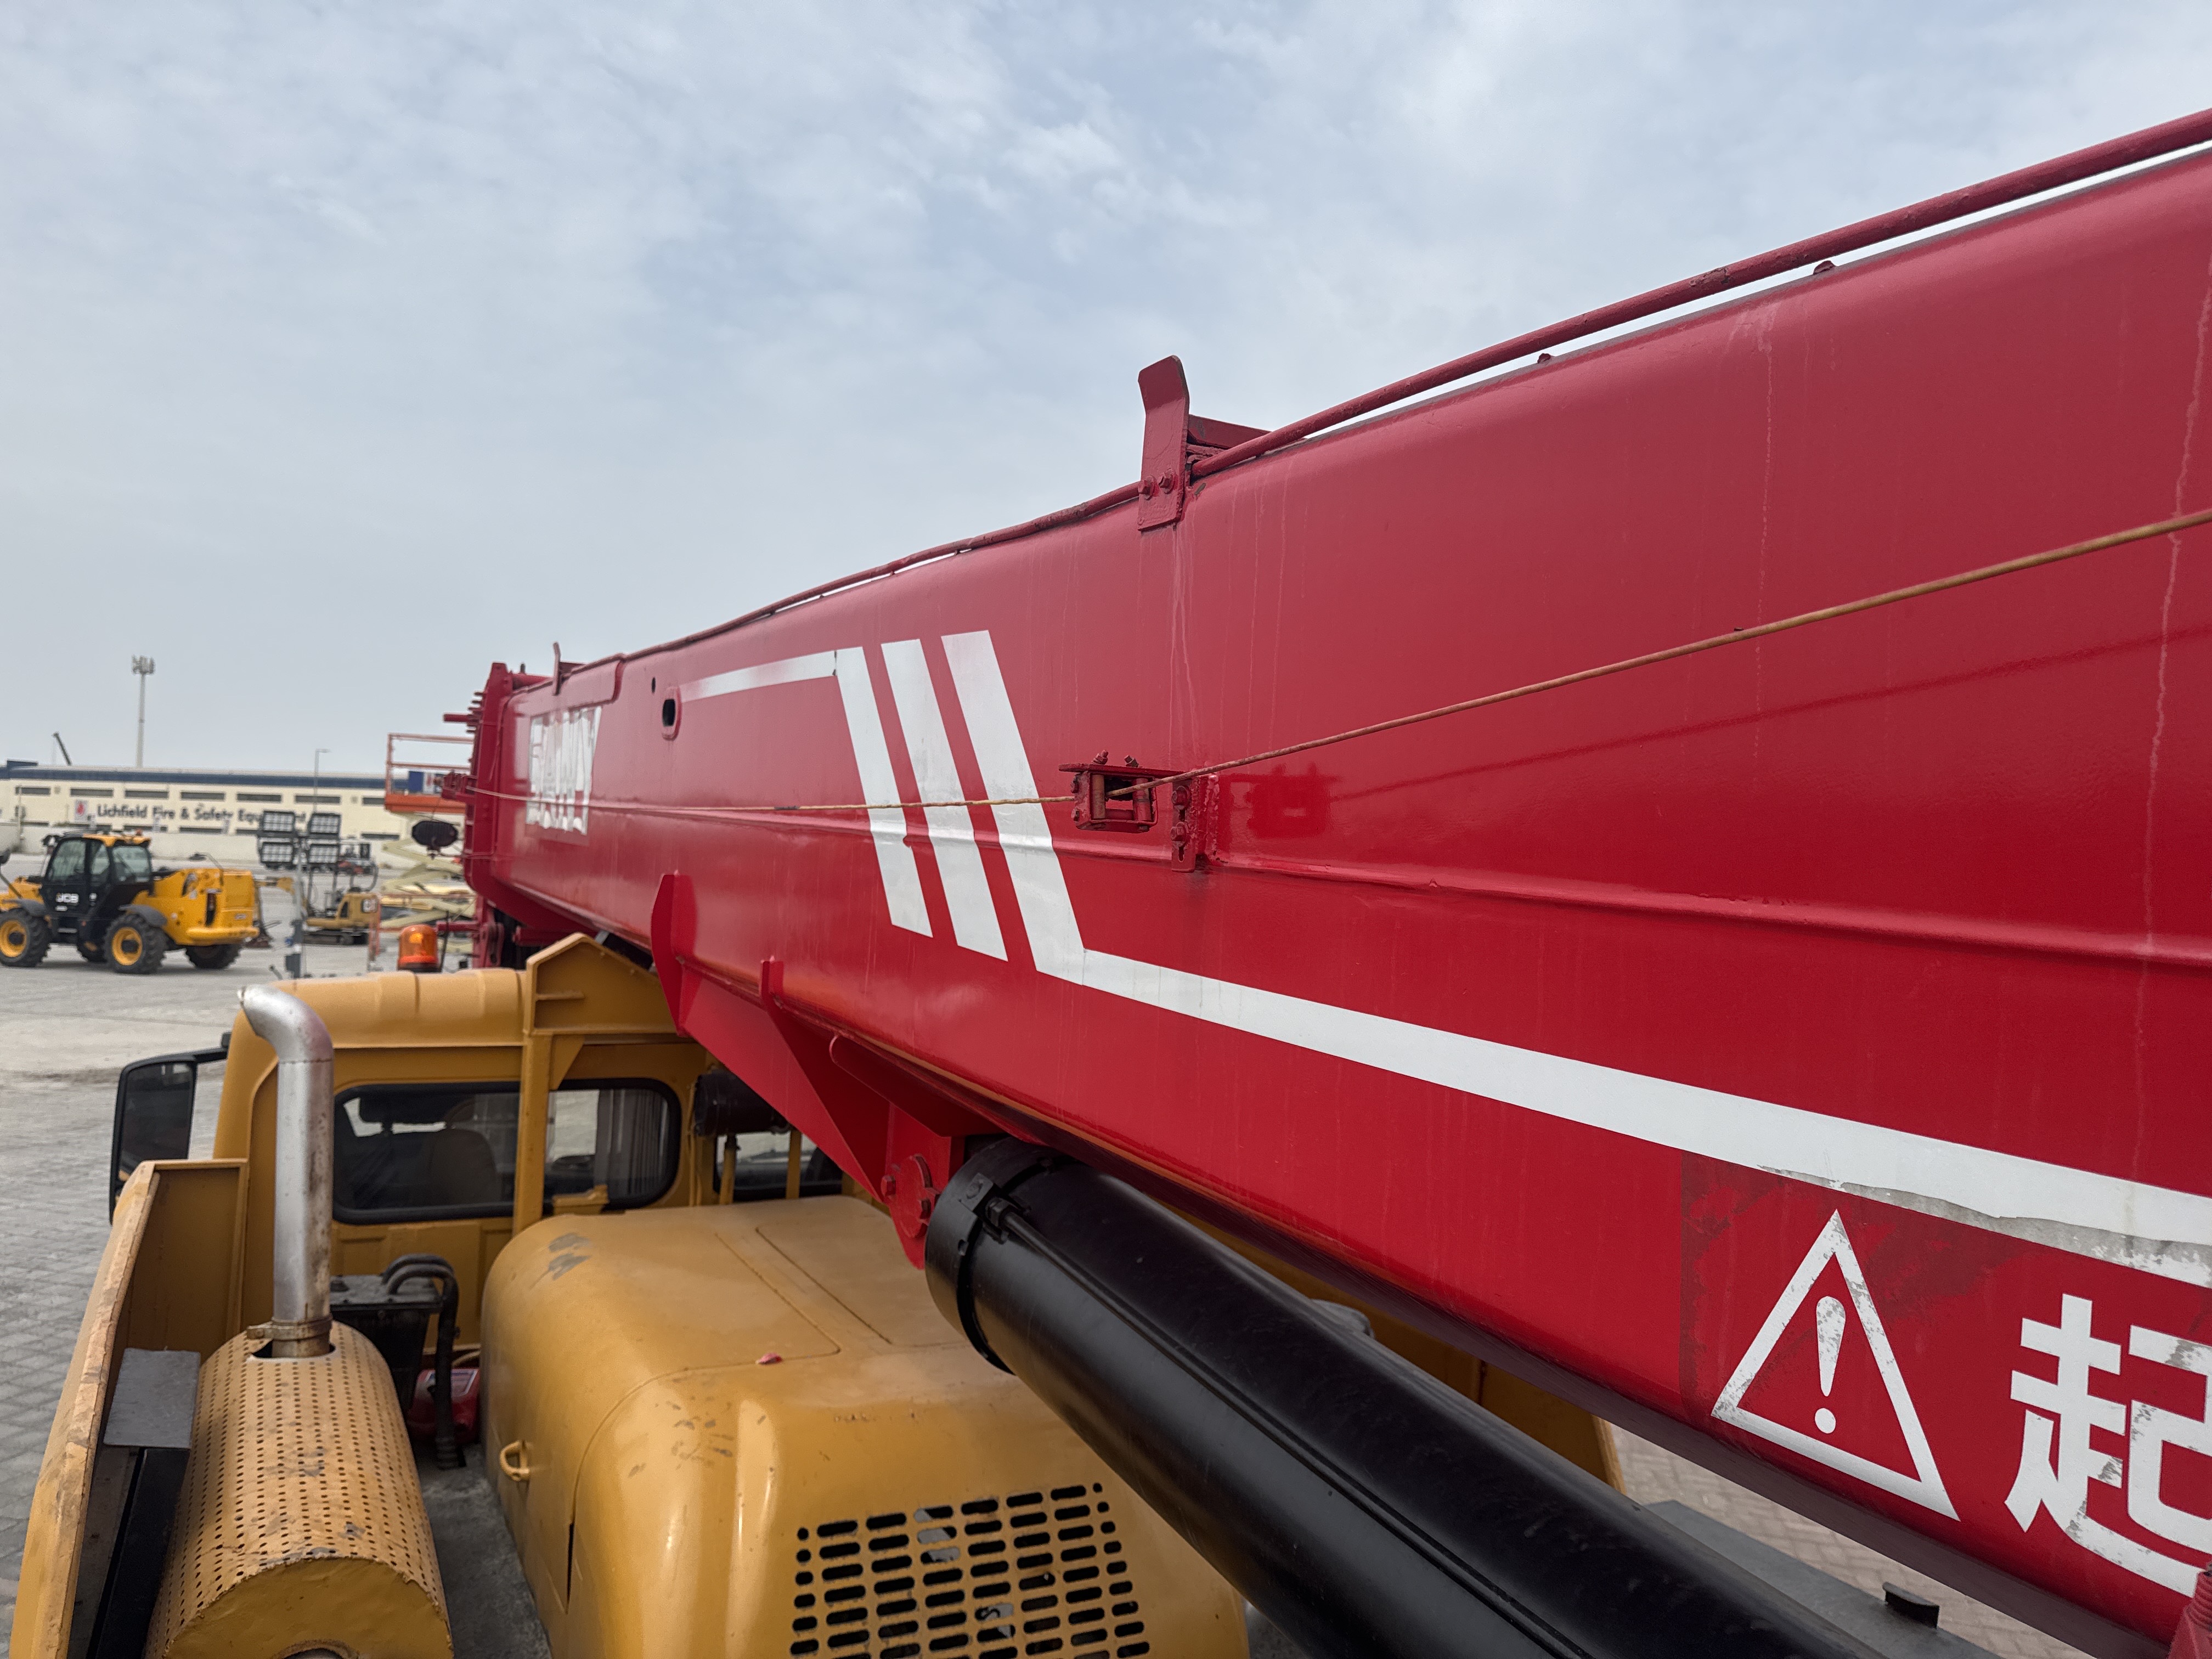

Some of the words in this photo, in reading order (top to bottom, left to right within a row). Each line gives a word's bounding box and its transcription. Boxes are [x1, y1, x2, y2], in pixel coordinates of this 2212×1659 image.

[97, 804, 148, 817] Lichfield
[180, 806, 189, 820] &
[56, 893, 79, 903] JCB
